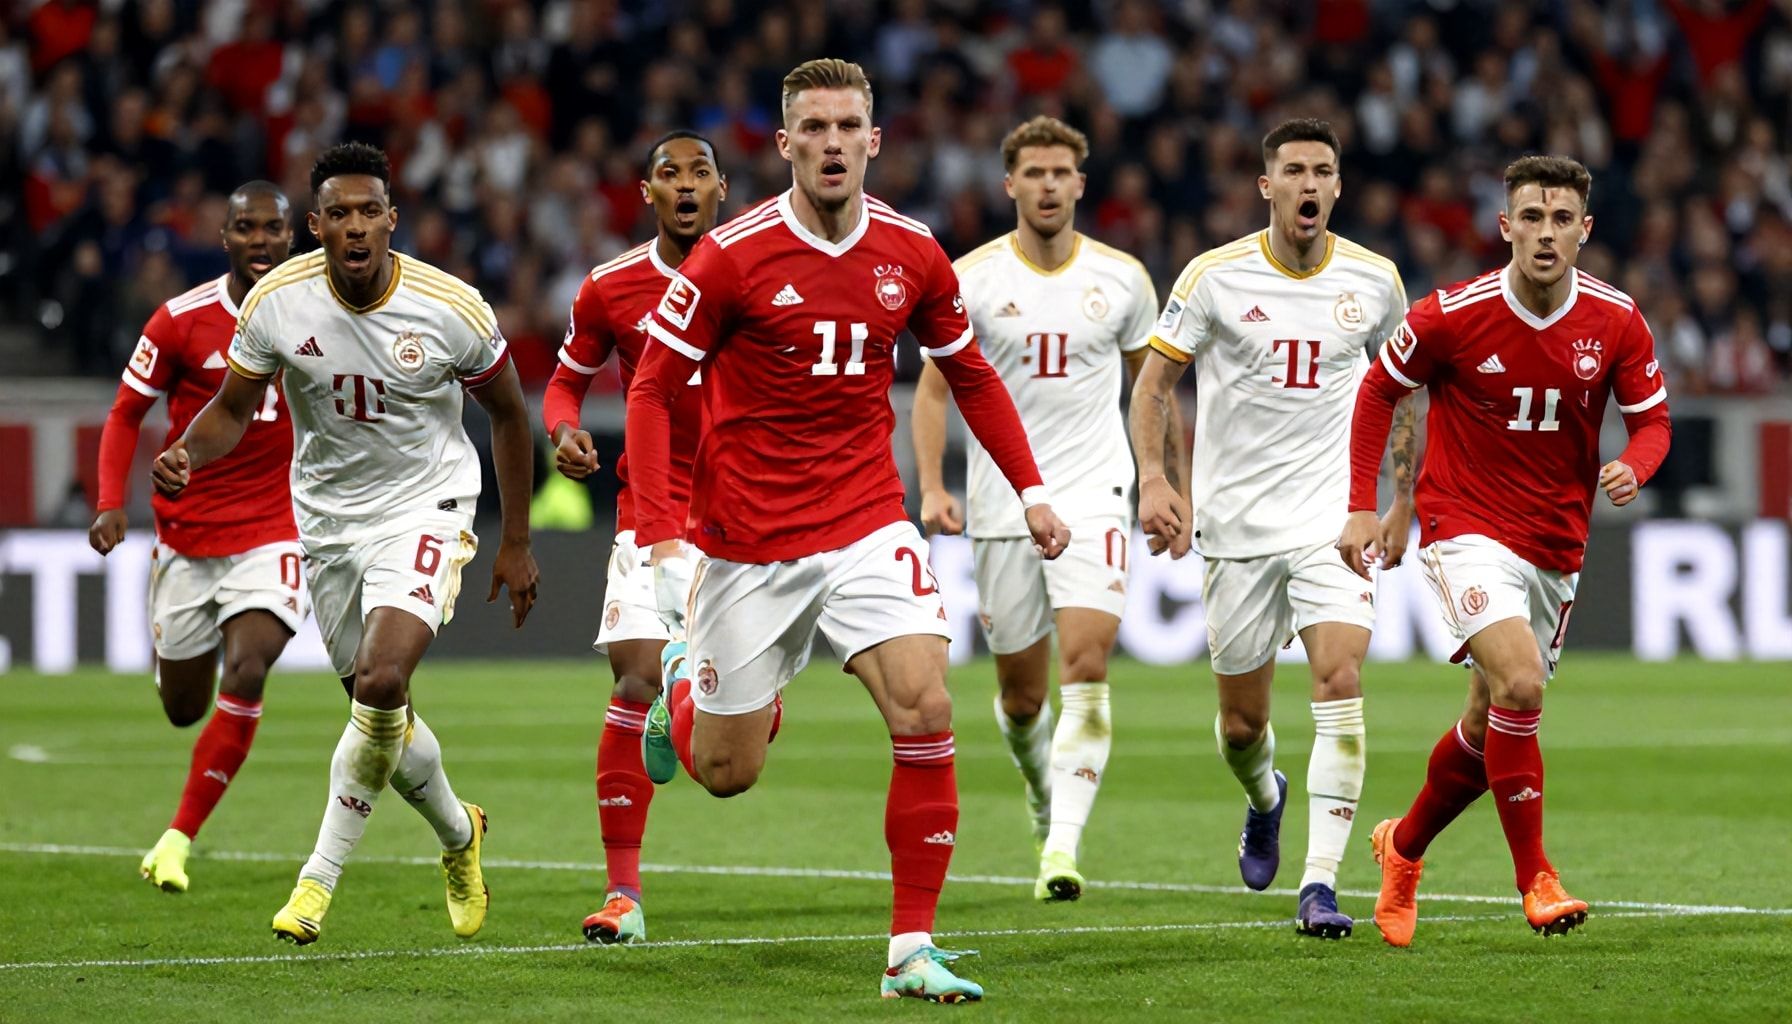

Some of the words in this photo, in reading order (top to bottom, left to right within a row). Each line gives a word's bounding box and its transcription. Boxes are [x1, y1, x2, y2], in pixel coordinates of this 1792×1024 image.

[811, 321, 869, 375] 11
[1507, 387, 1561, 431] 11
[415, 534, 444, 577] 6
